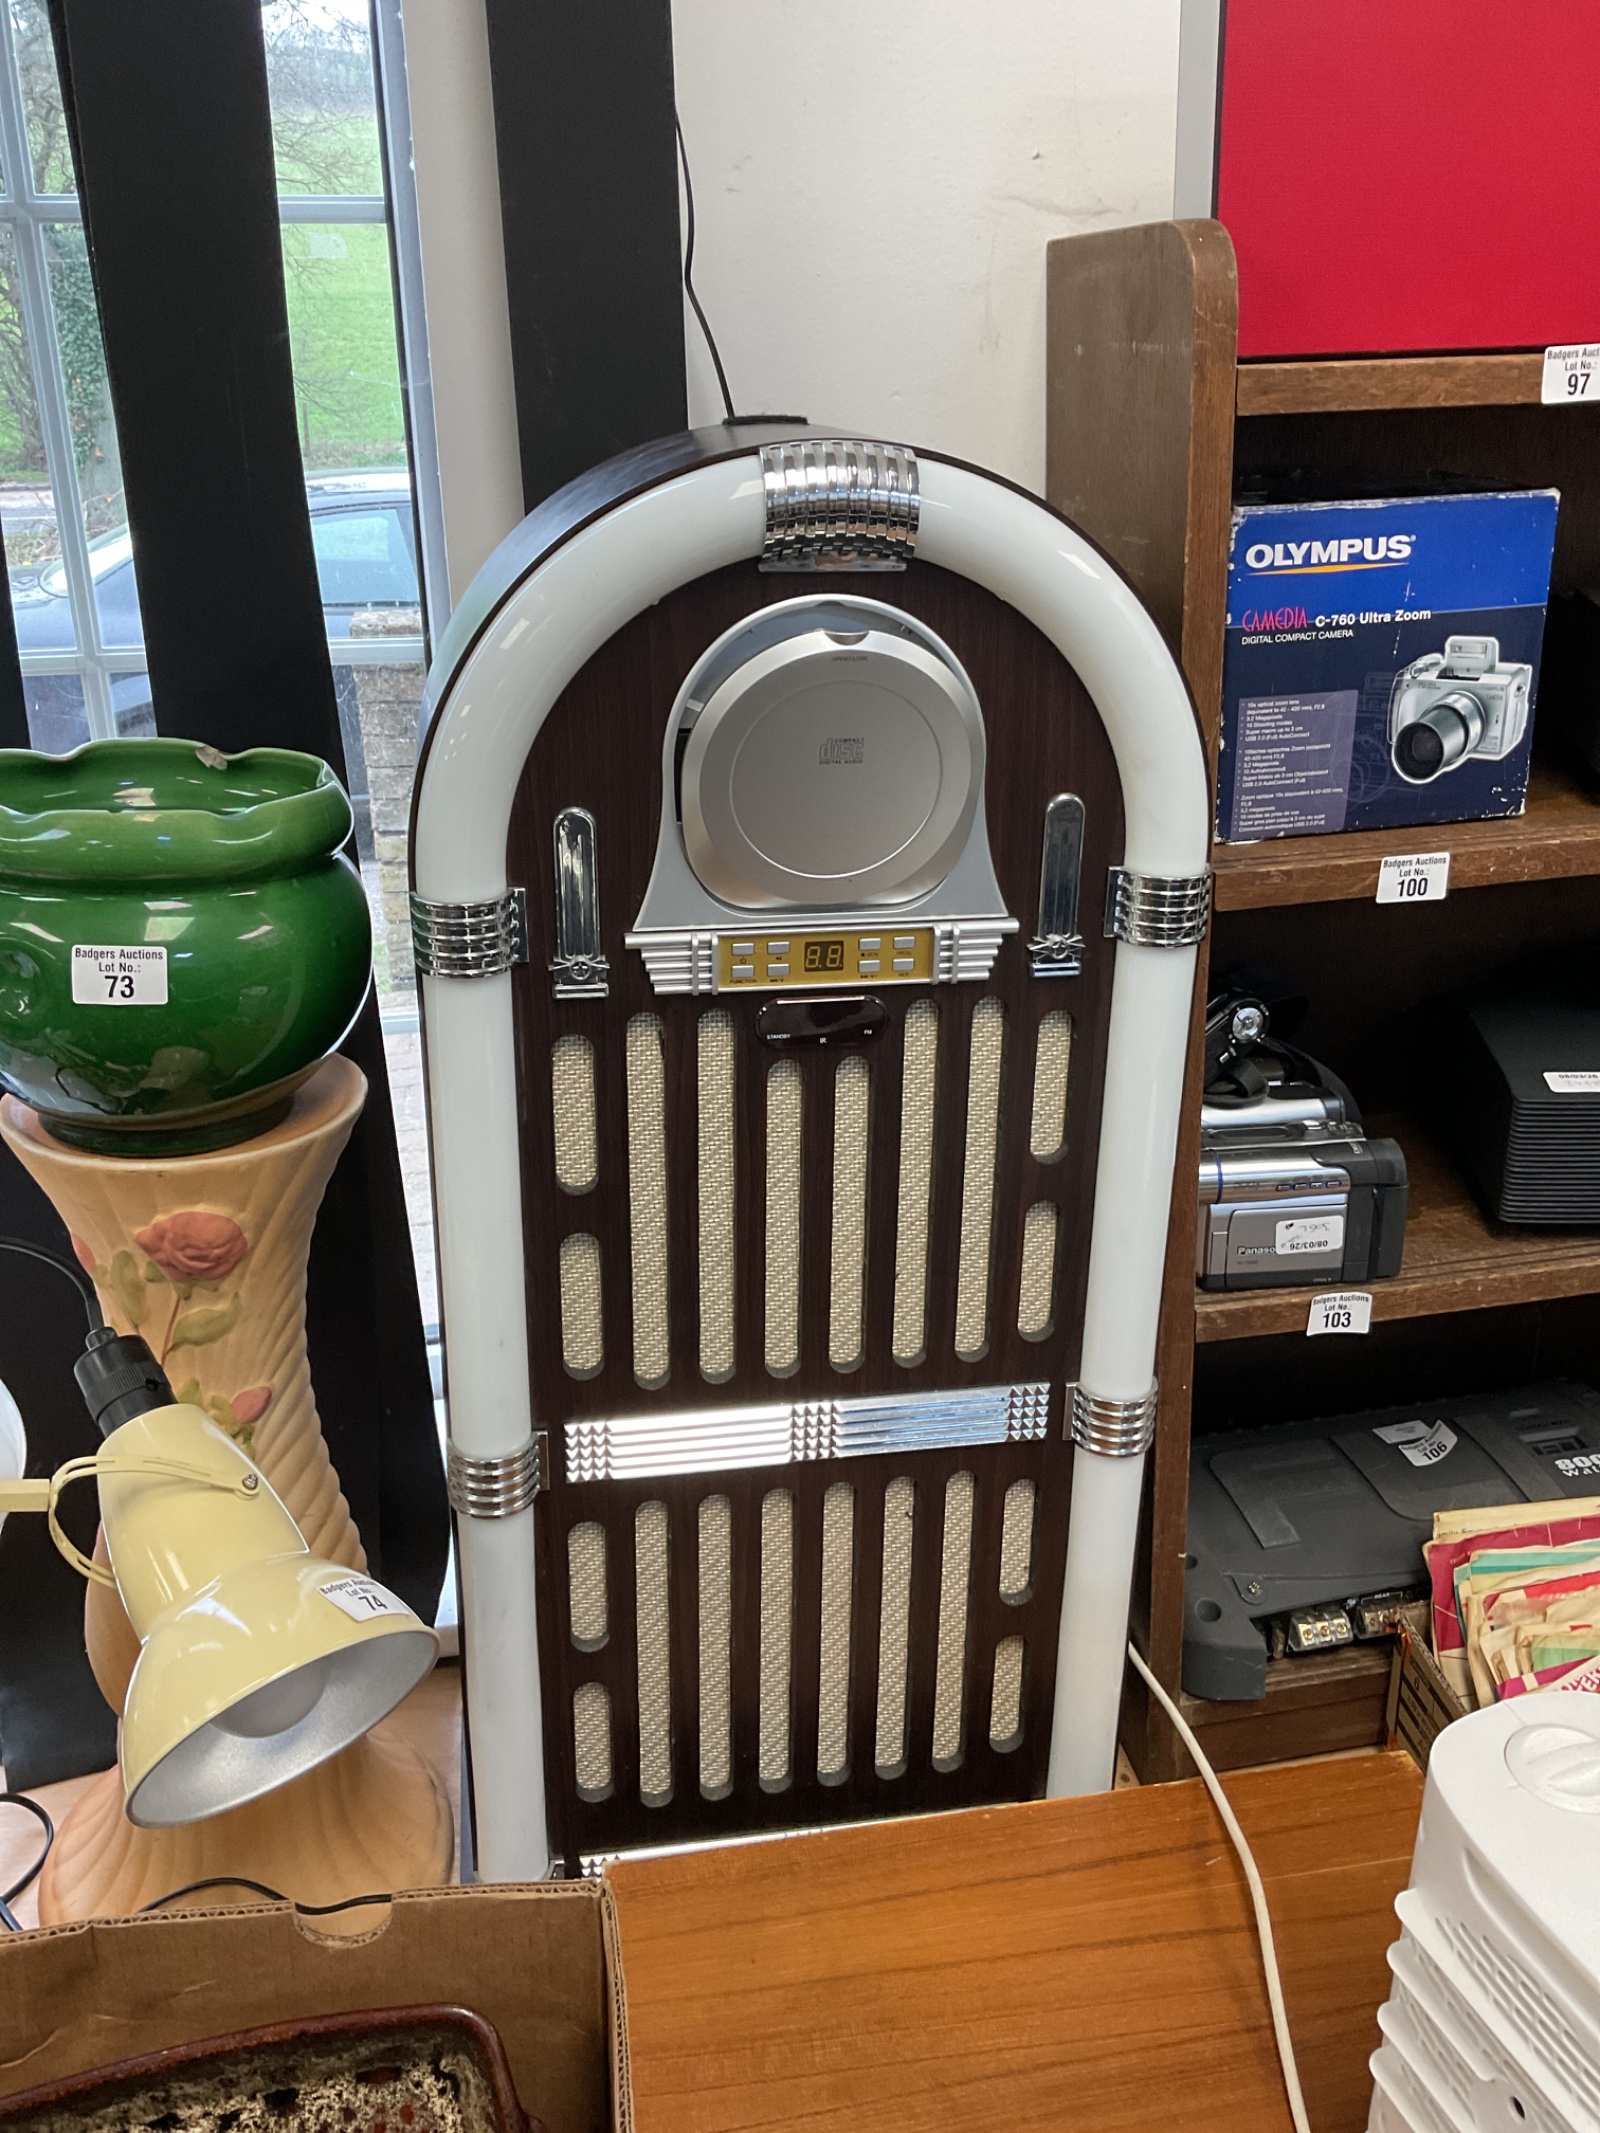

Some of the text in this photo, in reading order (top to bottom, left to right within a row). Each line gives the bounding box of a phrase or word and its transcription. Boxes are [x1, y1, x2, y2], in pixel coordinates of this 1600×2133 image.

[1548, 348, 1600, 360] Badgers Auct
[1565, 362, 1578, 371] Lot
[1567, 373, 1591, 396] 97
[1245, 534, 1412, 569] OLYMPUS
[1242, 606, 1431, 632] CAMEDIA C-760 Ultra Zoom
[1241, 629, 1354, 645] DIGITAL COMPACT CAMERA
[1383, 857, 1447, 869] Badgers Auctions
[1399, 869, 1411, 877] Lot
[1398, 878, 1428, 897] 100
[75, 948, 163, 960] Badgers Auctions
[98, 962, 141, 973] Lot No.:
[104, 975, 134, 998] 73
[1237, 1246, 1276, 1255] Panaso
[1290, 1240, 1328, 1250] 08/03/26
[1339, 1294, 1369, 1302] Auctions
[1324, 1304, 1336, 1312] Lot
[1323, 1312, 1352, 1328] 103
[1422, 1441, 1448, 1461] 106
[1562, 1465, 1600, 1477] Wat
[358, 1594, 388, 1611] 74
